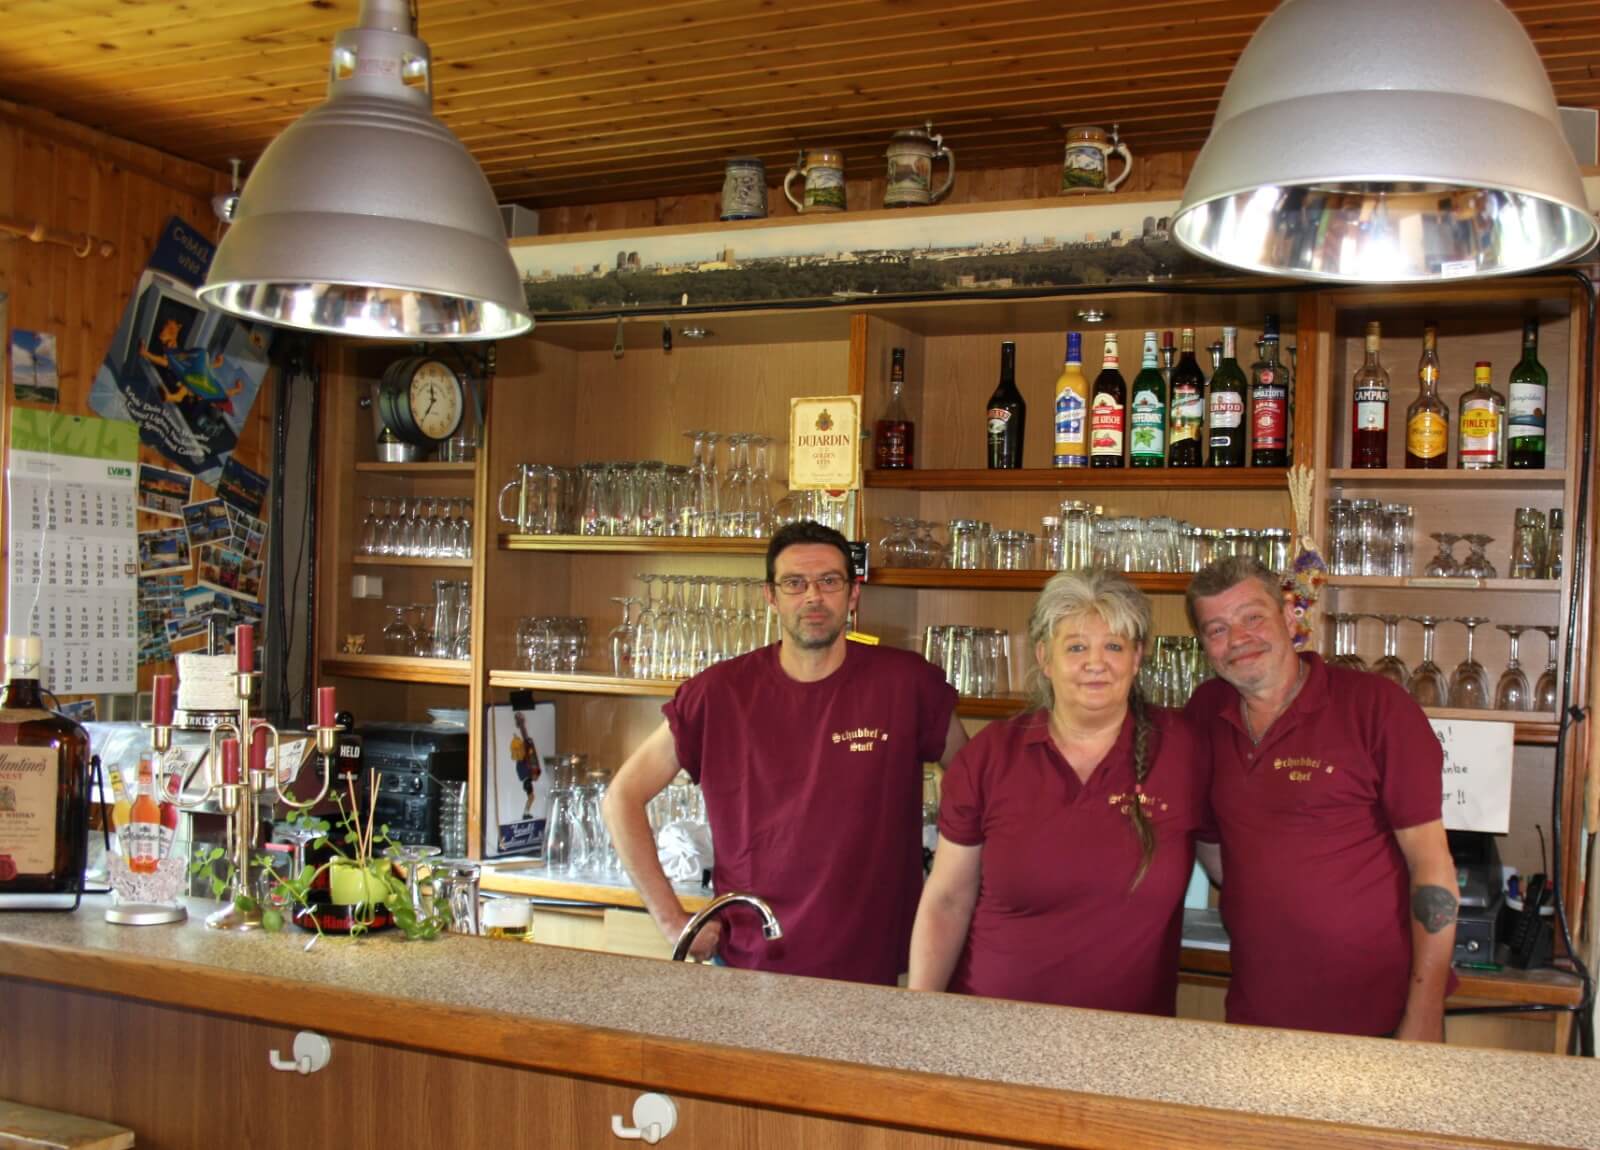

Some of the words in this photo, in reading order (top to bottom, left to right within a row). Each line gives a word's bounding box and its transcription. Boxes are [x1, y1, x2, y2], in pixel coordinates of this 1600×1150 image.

[1355, 390, 1389, 401] CAMPARI
[1462, 419, 1496, 428] FINLEY'S
[798, 434, 850, 448] DUJARDIN
[340, 745, 360, 758] HELD
[850, 742, 873, 752] Staff
